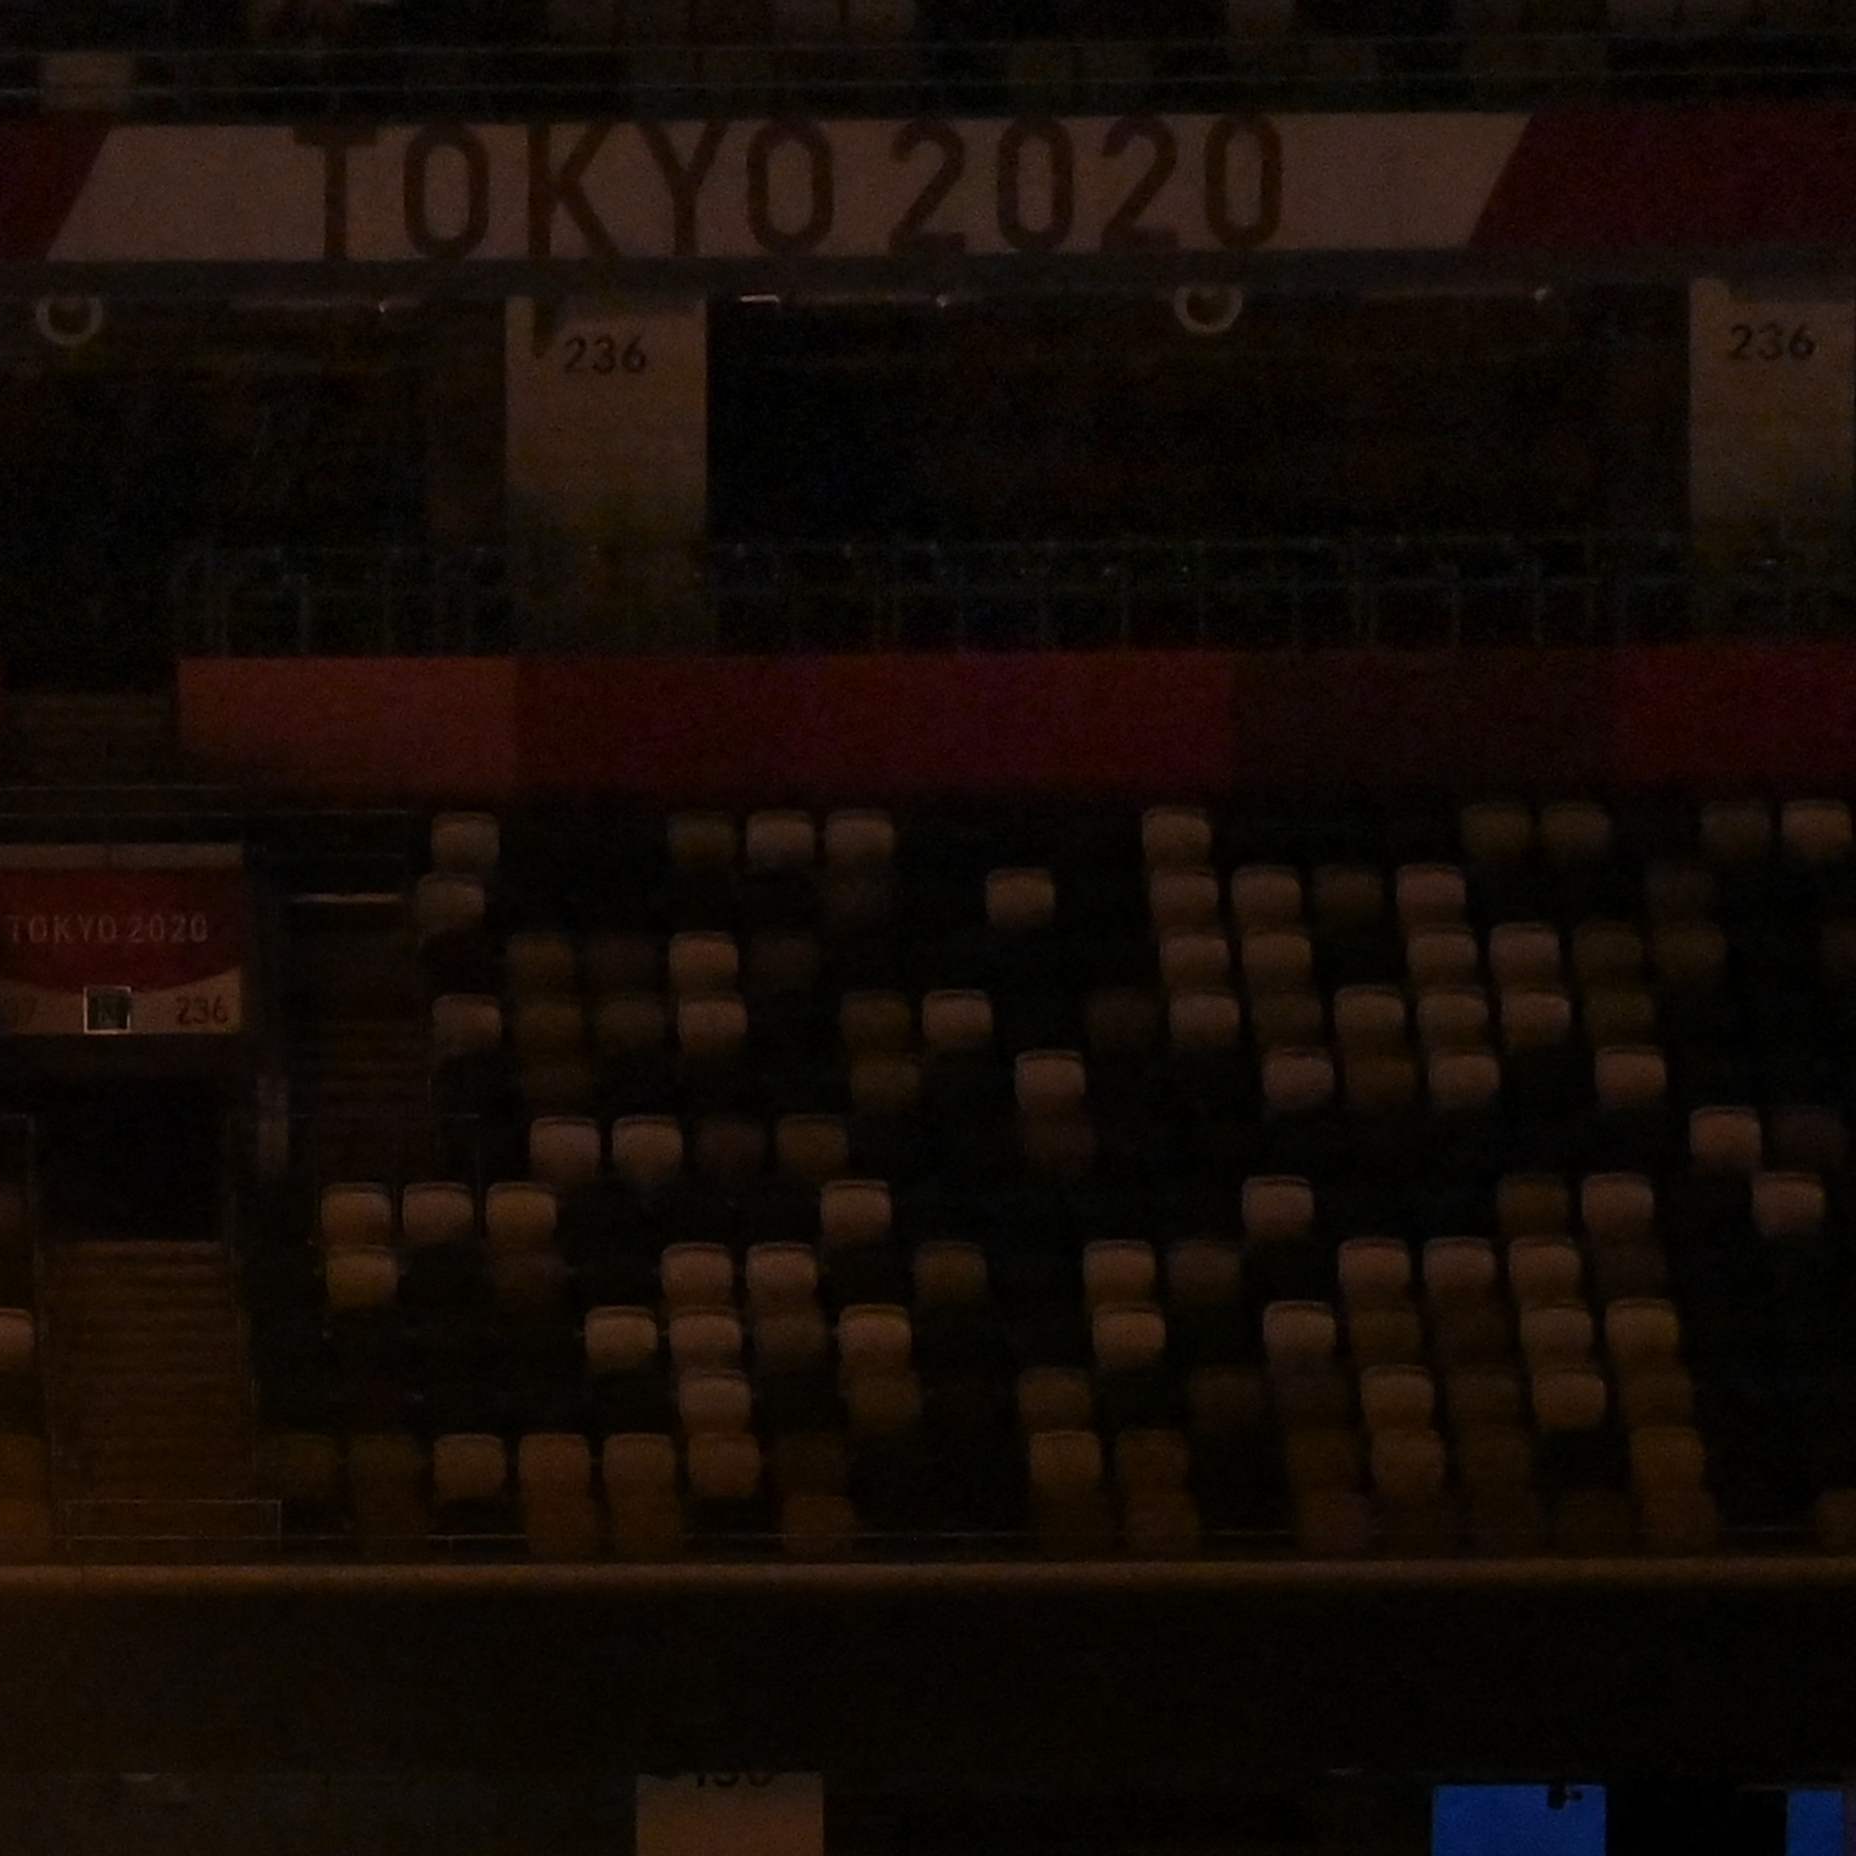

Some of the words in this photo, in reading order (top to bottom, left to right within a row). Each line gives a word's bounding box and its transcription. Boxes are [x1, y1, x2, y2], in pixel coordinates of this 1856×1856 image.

[293, 112, 834, 261] TOKYO
[890, 108, 1282, 258] 2020
[564, 336, 647, 375] 236
[1727, 321, 1816, 361] 236
[4, 912, 118, 944] TOKYO
[128, 912, 209, 944] 2020
[176, 995, 229, 1026] 236
